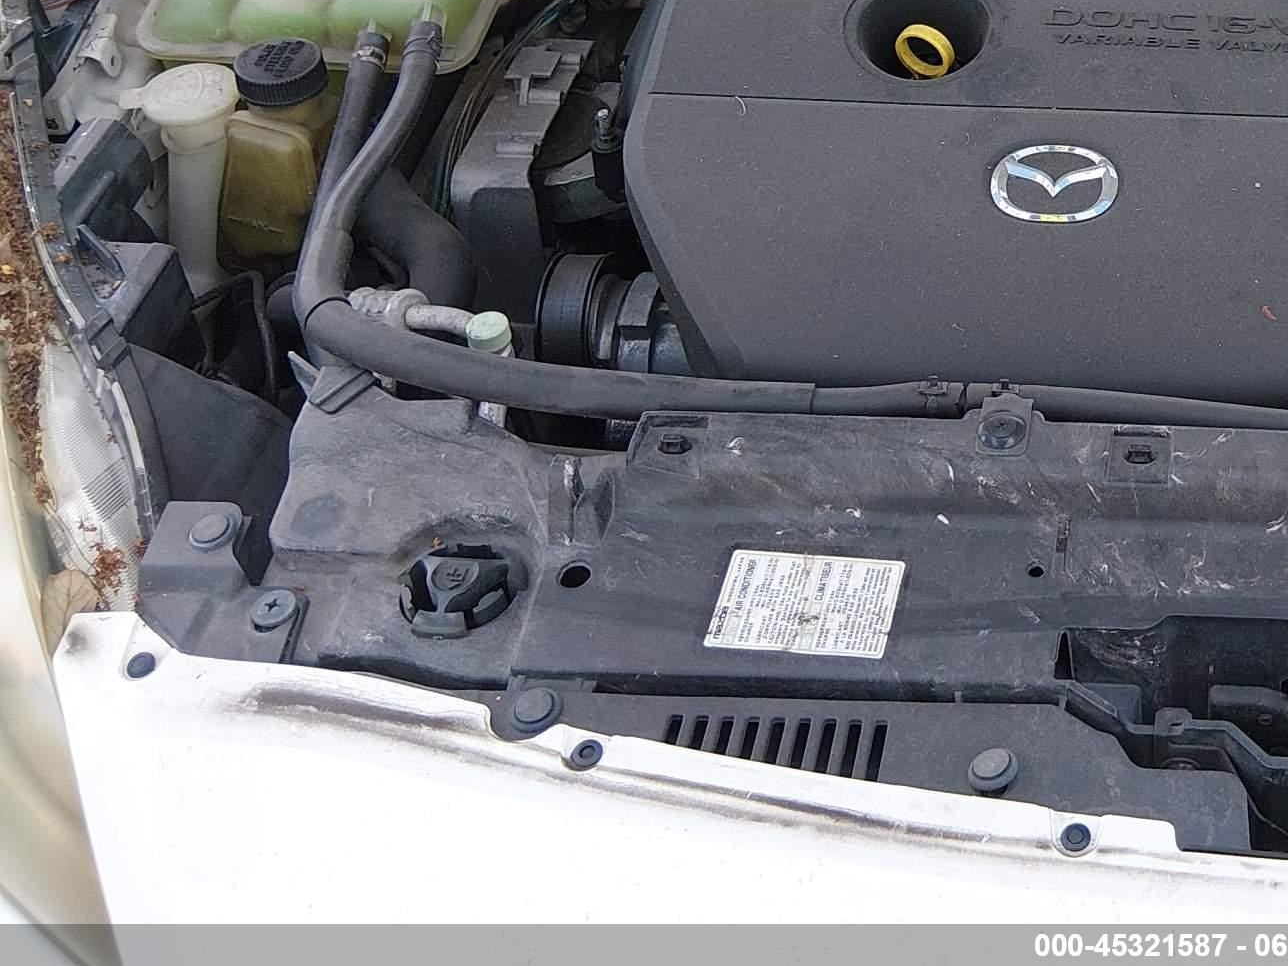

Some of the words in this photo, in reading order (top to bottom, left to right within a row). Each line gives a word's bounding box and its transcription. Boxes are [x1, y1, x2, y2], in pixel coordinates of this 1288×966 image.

[1043, 9, 1196, 31] DOHC
[1053, 32, 1201, 50] VARIABLE
[738, 559, 757, 598] CONDITIONER
[814, 561, 832, 600] CLIMATISEUR
[733, 600, 744, 610] AIR
[713, 606, 729, 639] mazda
